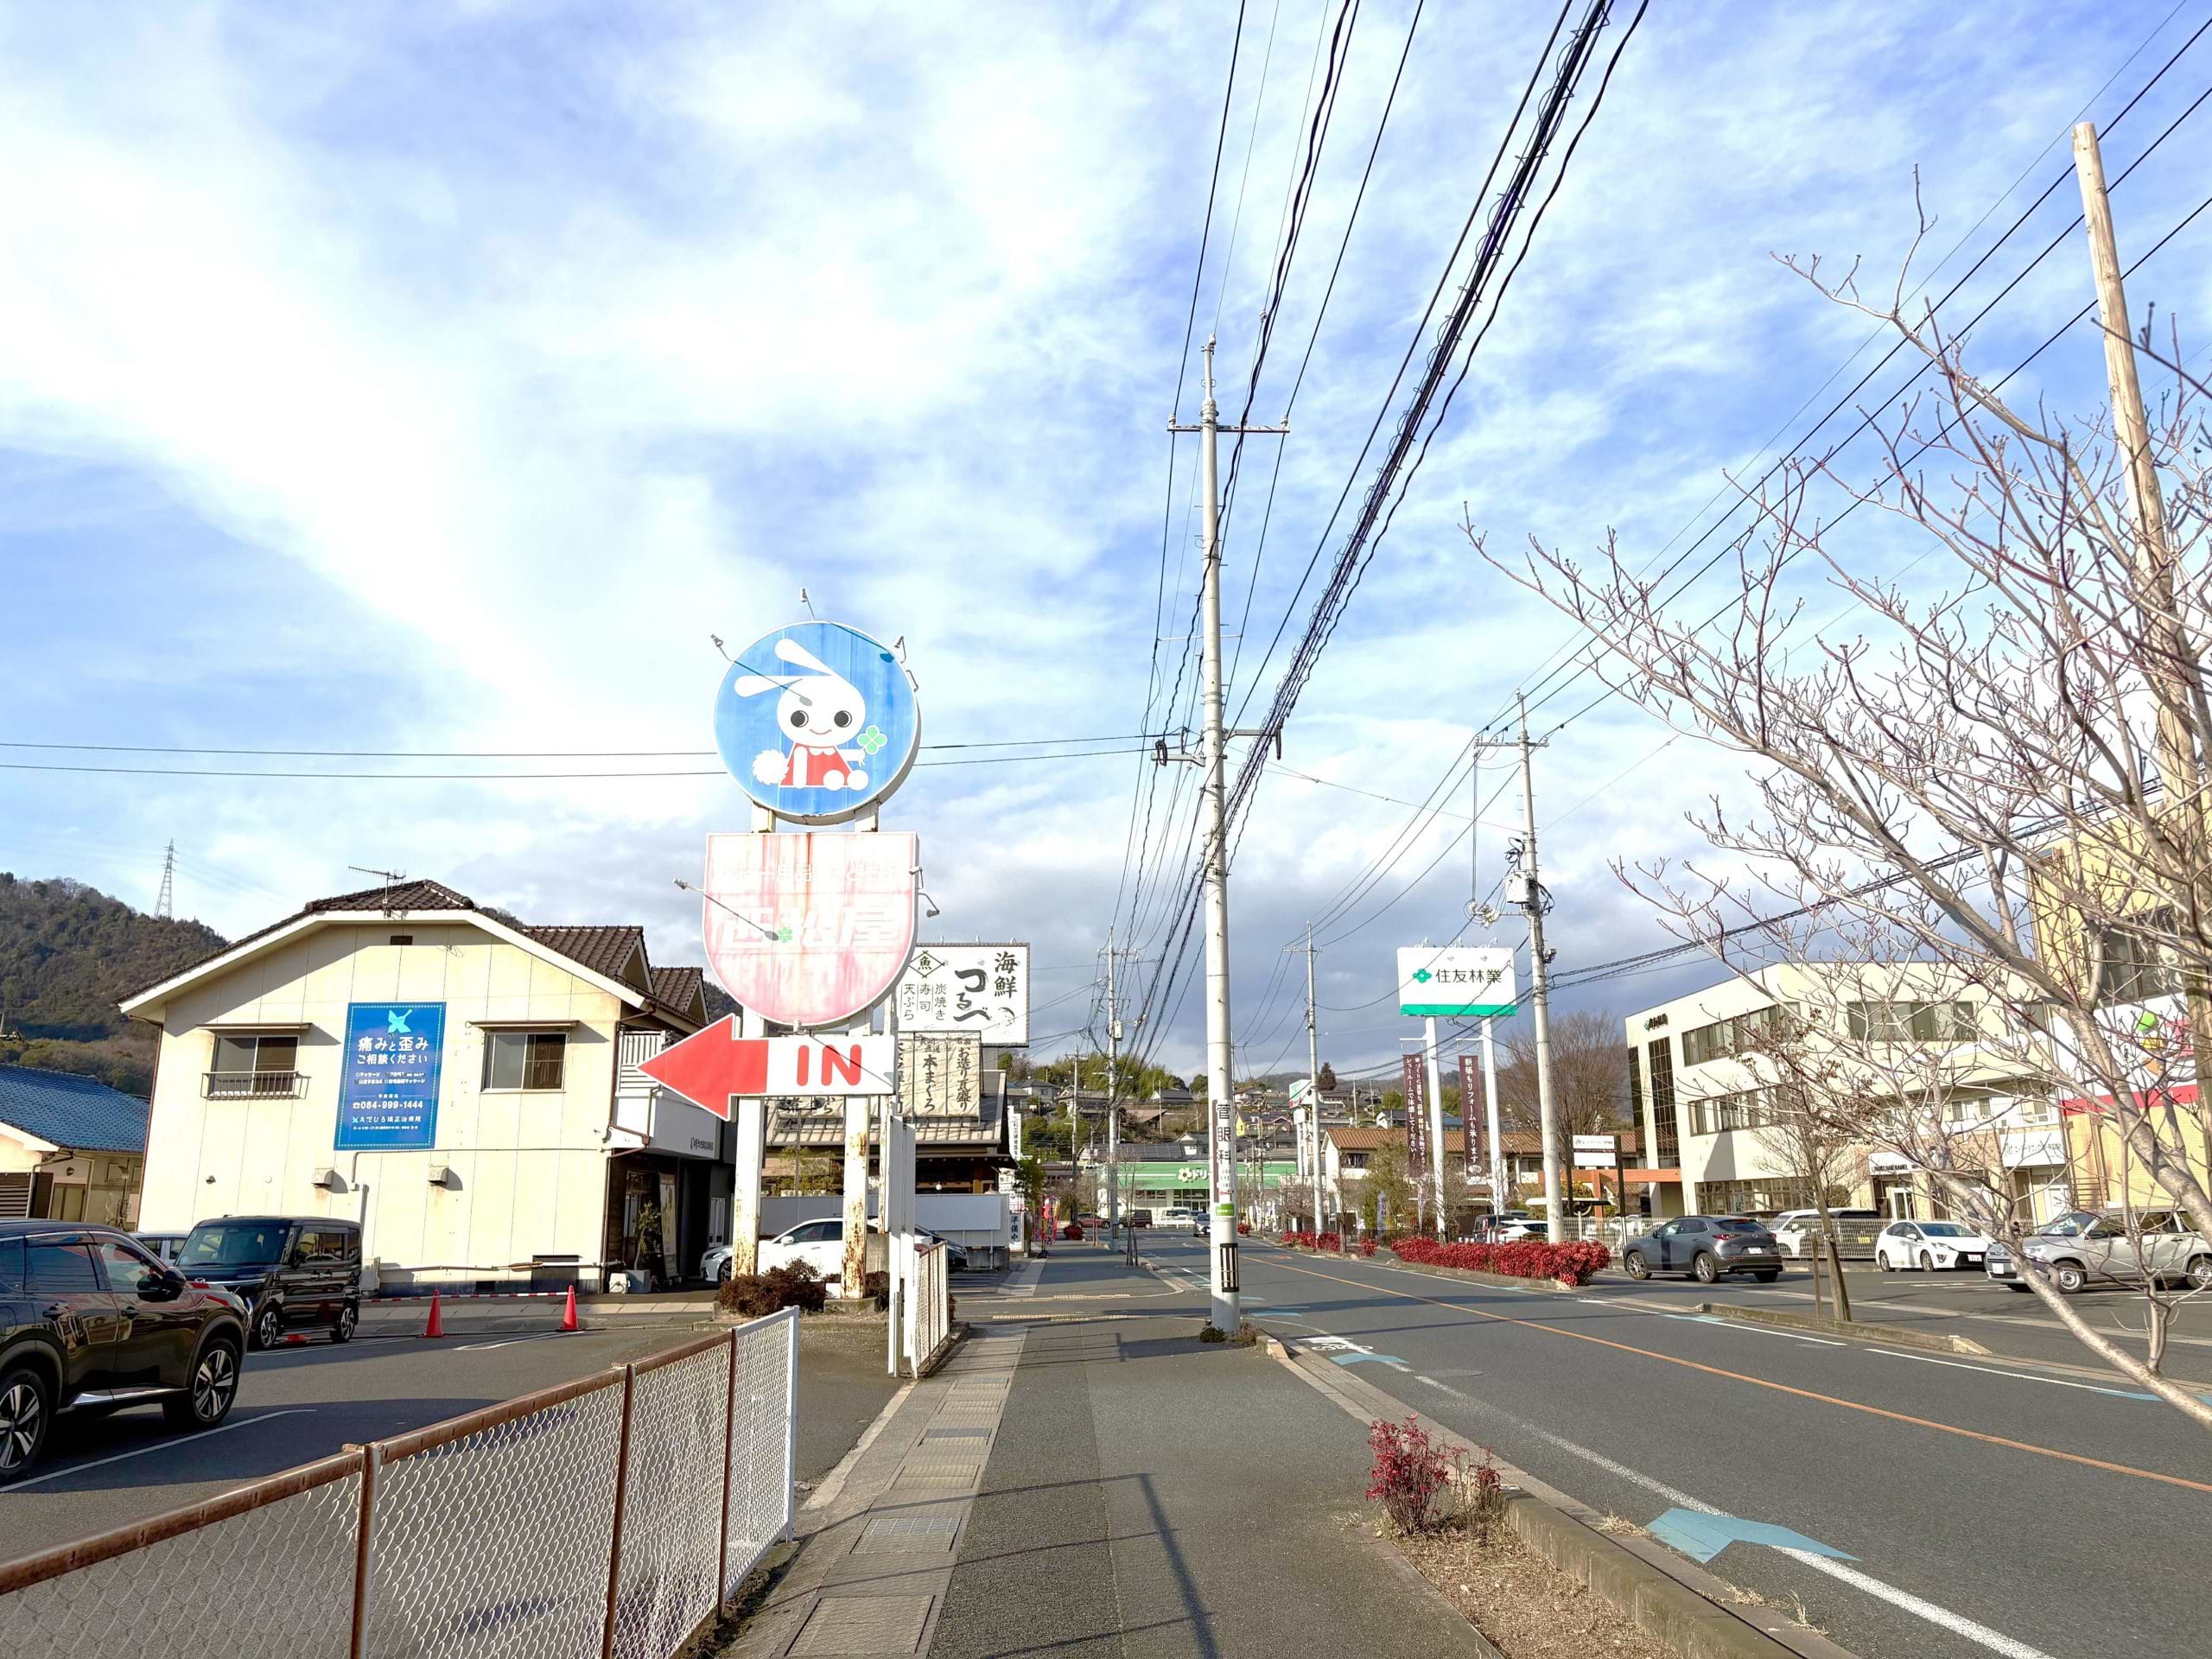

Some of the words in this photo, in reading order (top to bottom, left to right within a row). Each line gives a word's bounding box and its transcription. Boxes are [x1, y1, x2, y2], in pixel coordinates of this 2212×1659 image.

[918, 956, 932, 970] 魚
[994, 951, 1018, 998] 海鮮
[1435, 969, 1502, 983] 住友林業
[918, 982, 931, 1012] 寿司
[934, 982, 947, 1020] 炭焼き
[953, 968, 992, 1022] つるべ
[357, 1053, 428, 1065] ご相談ください
[358, 1036, 429, 1052] 痛みと歪み
[797, 1044, 861, 1086] IN
[922, 1054, 938, 1113] 本まぐろ
[360, 1100, 423, 1109] 084-999-1444
[1464, 1058, 1479, 1164] 新築もリフォームも承ります
